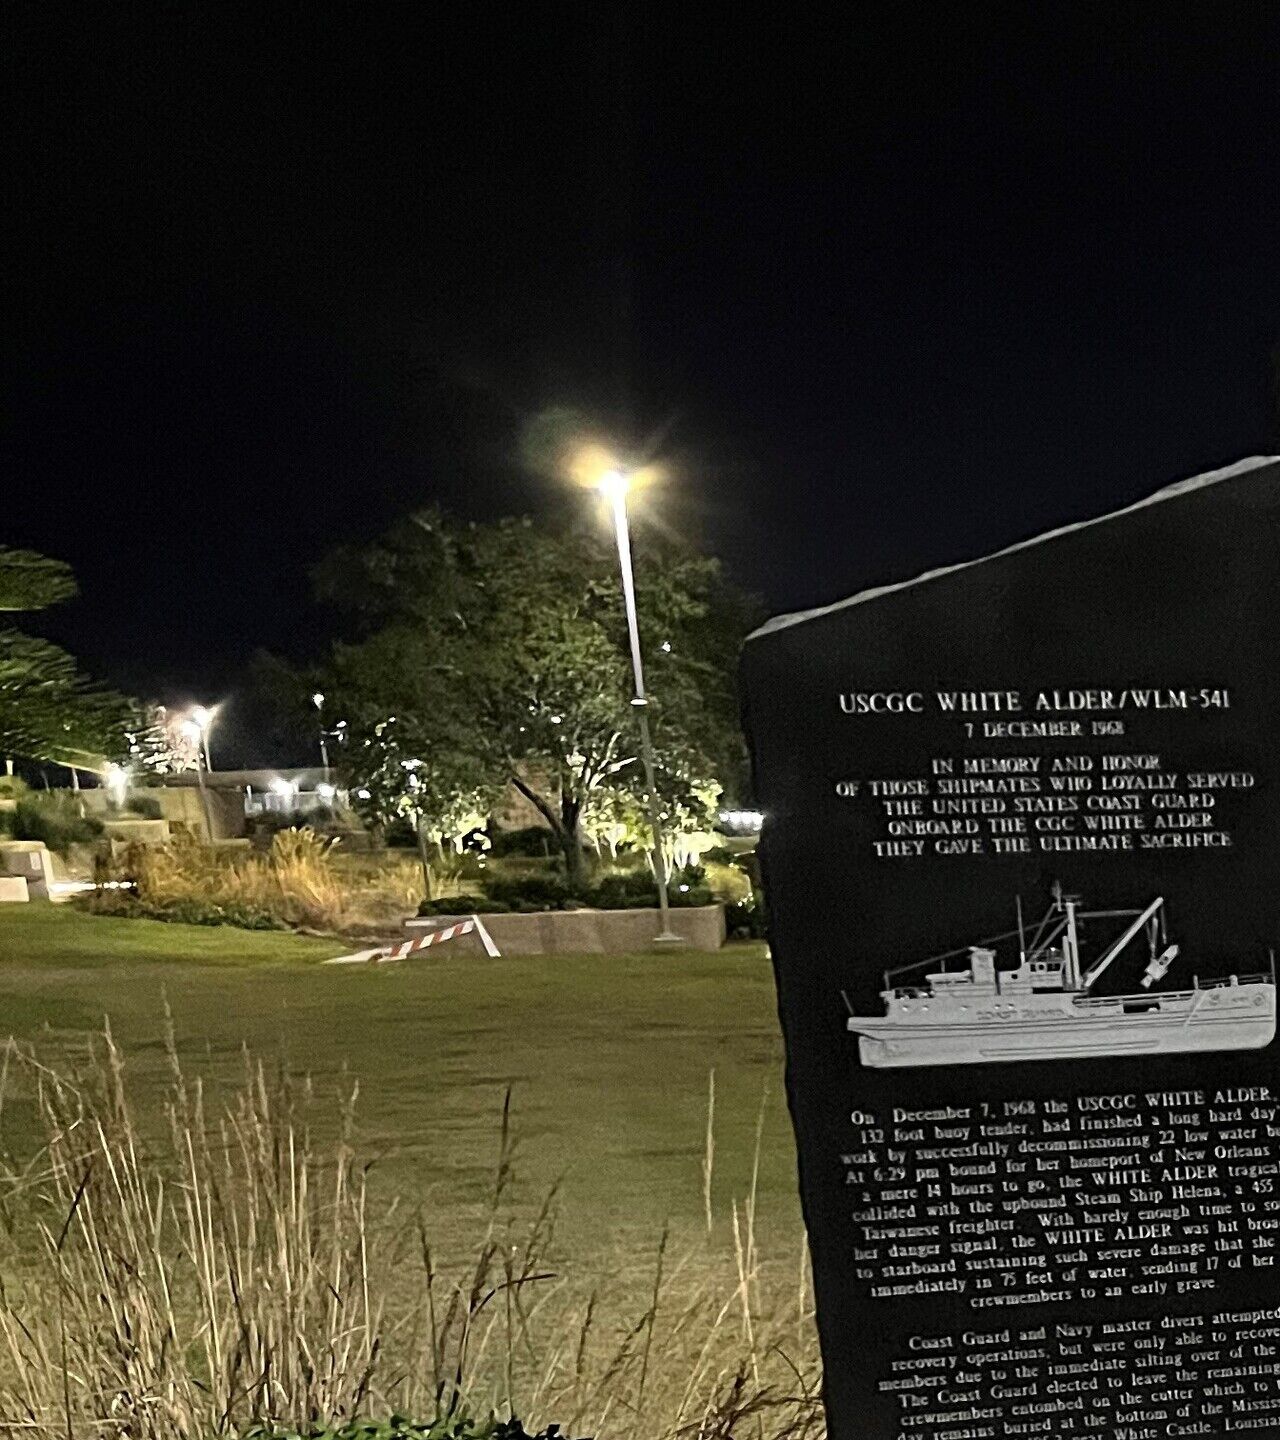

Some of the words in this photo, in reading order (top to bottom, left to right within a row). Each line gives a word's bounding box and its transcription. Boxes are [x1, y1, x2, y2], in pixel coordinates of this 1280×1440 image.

[838, 691, 923, 714] USCGC
[935, 690, 1022, 712] WHITE
[1034, 687, 1230, 711] ALDER/WLM-541
[963, 721, 974, 739] 7
[982, 720, 1083, 738] DECEMBER
[931, 757, 953, 775] IN
[962, 756, 1040, 774] MEMORY
[1050, 755, 1094, 772] AND
[1101, 754, 1161, 771] HONOR
[834, 781, 859, 797] OF
[868, 779, 929, 797] THOSE
[936, 776, 1041, 794] SHIPMATES
[1048, 775, 1093, 792] WHO
[1100, 773, 1177, 791] LOYALLY
[1185, 772, 1255, 789] SERVED
[881, 798, 923, 816] THE
[931, 797, 1007, 815] UNITED
[1012, 795, 1079, 813] STATES
[1085, 793, 1141, 810] COAST
[1150, 792, 1216, 809] GUARD
[886, 818, 980, 836] ONBOARD
[986, 816, 1027, 834] THE
[1033, 815, 1074, 831] CGC
[1082, 813, 1145, 831] WHITE
[1153, 811, 1213, 829] ALDER
[871, 839, 925, 857] THEY
[933, 837, 984, 855] GAVE
[990, 836, 1031, 853] THE
[1038, 833, 1133, 851] ULTIMATE
[1139, 831, 1231, 849] SACRIFICE
[849, 1109, 875, 1125] On
[892, 1105, 971, 1123] December
[1003, 1100, 1036, 1116] 1968
[1042, 1099, 1068, 1114] the
[1076, 1093, 1136, 1112] USCGC
[1143, 1089, 1205, 1107] WHITE
[861, 1191, 871, 1202] a
[879, 1187, 918, 1201] mere
[926, 1182, 942, 1198] 14
[949, 1181, 994, 1196] hours
[1000, 1180, 1019, 1192] to
[1057, 1174, 1083, 1189] the
[1090, 1168, 1152, 1186] WHITE
[1159, 1163, 1219, 1182] ALDER
[851, 1203, 917, 1222] collided
[925, 1200, 961, 1217] with
[967, 1199, 993, 1214] the
[1001, 1193, 1067, 1214] upbound
[1074, 1191, 1122, 1206] Steam
[1128, 1187, 1164, 1204] Ship
[1233, 1184, 1243, 1195] a
[1251, 1177, 1274, 1194] 455
